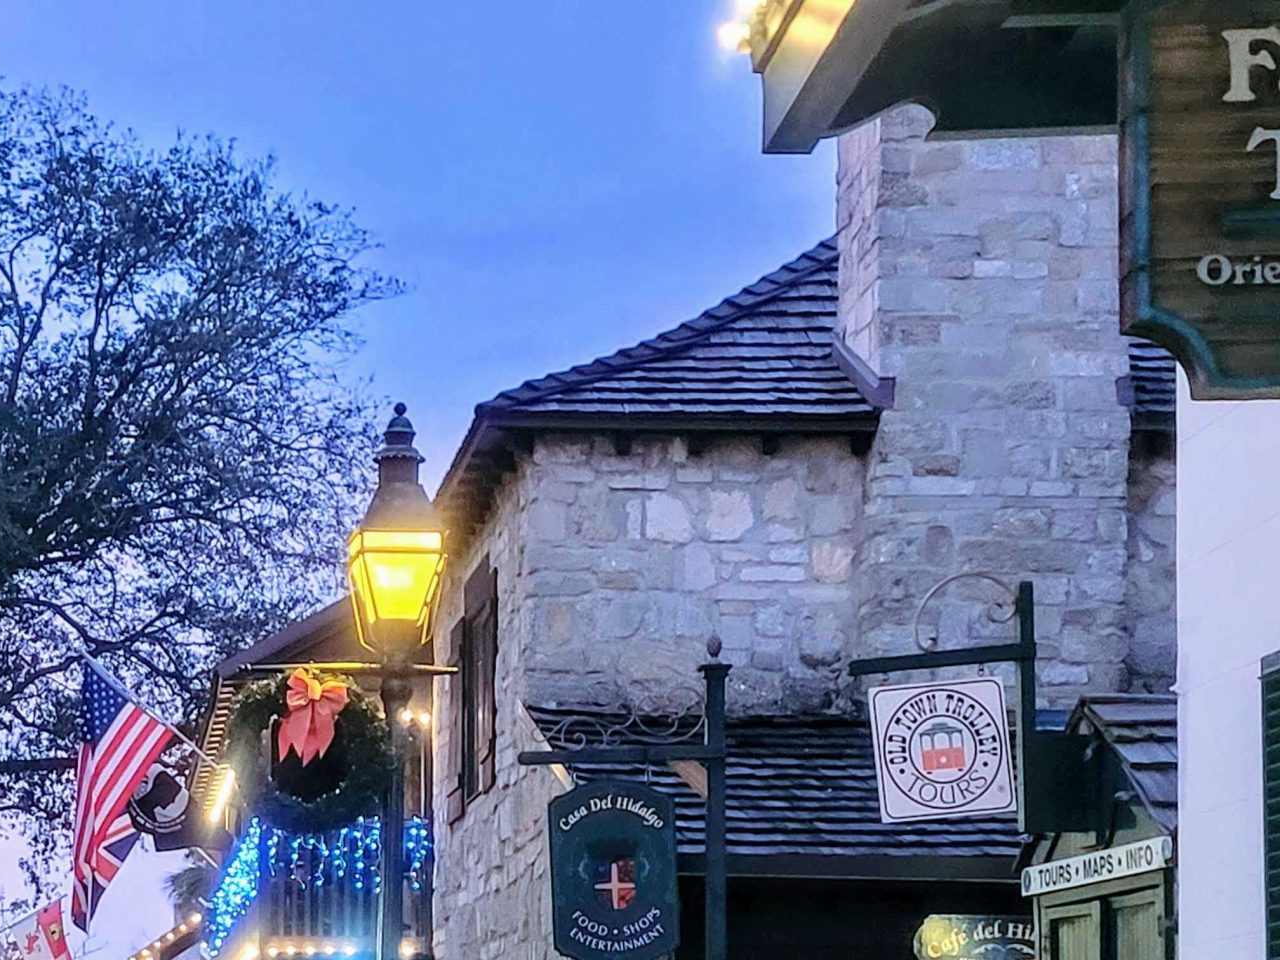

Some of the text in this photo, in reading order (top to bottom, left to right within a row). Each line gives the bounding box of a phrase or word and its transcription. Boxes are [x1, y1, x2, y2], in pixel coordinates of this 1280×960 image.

[888, 694, 998, 765] OLD TOWN TROLLEY
[908, 769, 987, 804] TOURS
[559, 794, 664, 831] Casa Del Hidalgo
[1038, 844, 1153, 888] TOURS MAPS INFO
[570, 924, 665, 952] ENTERTAINMENT
[572, 906, 661, 936] FOOD SHOPS
[927, 923, 968, 958] Café
[973, 920, 1002, 941] del
